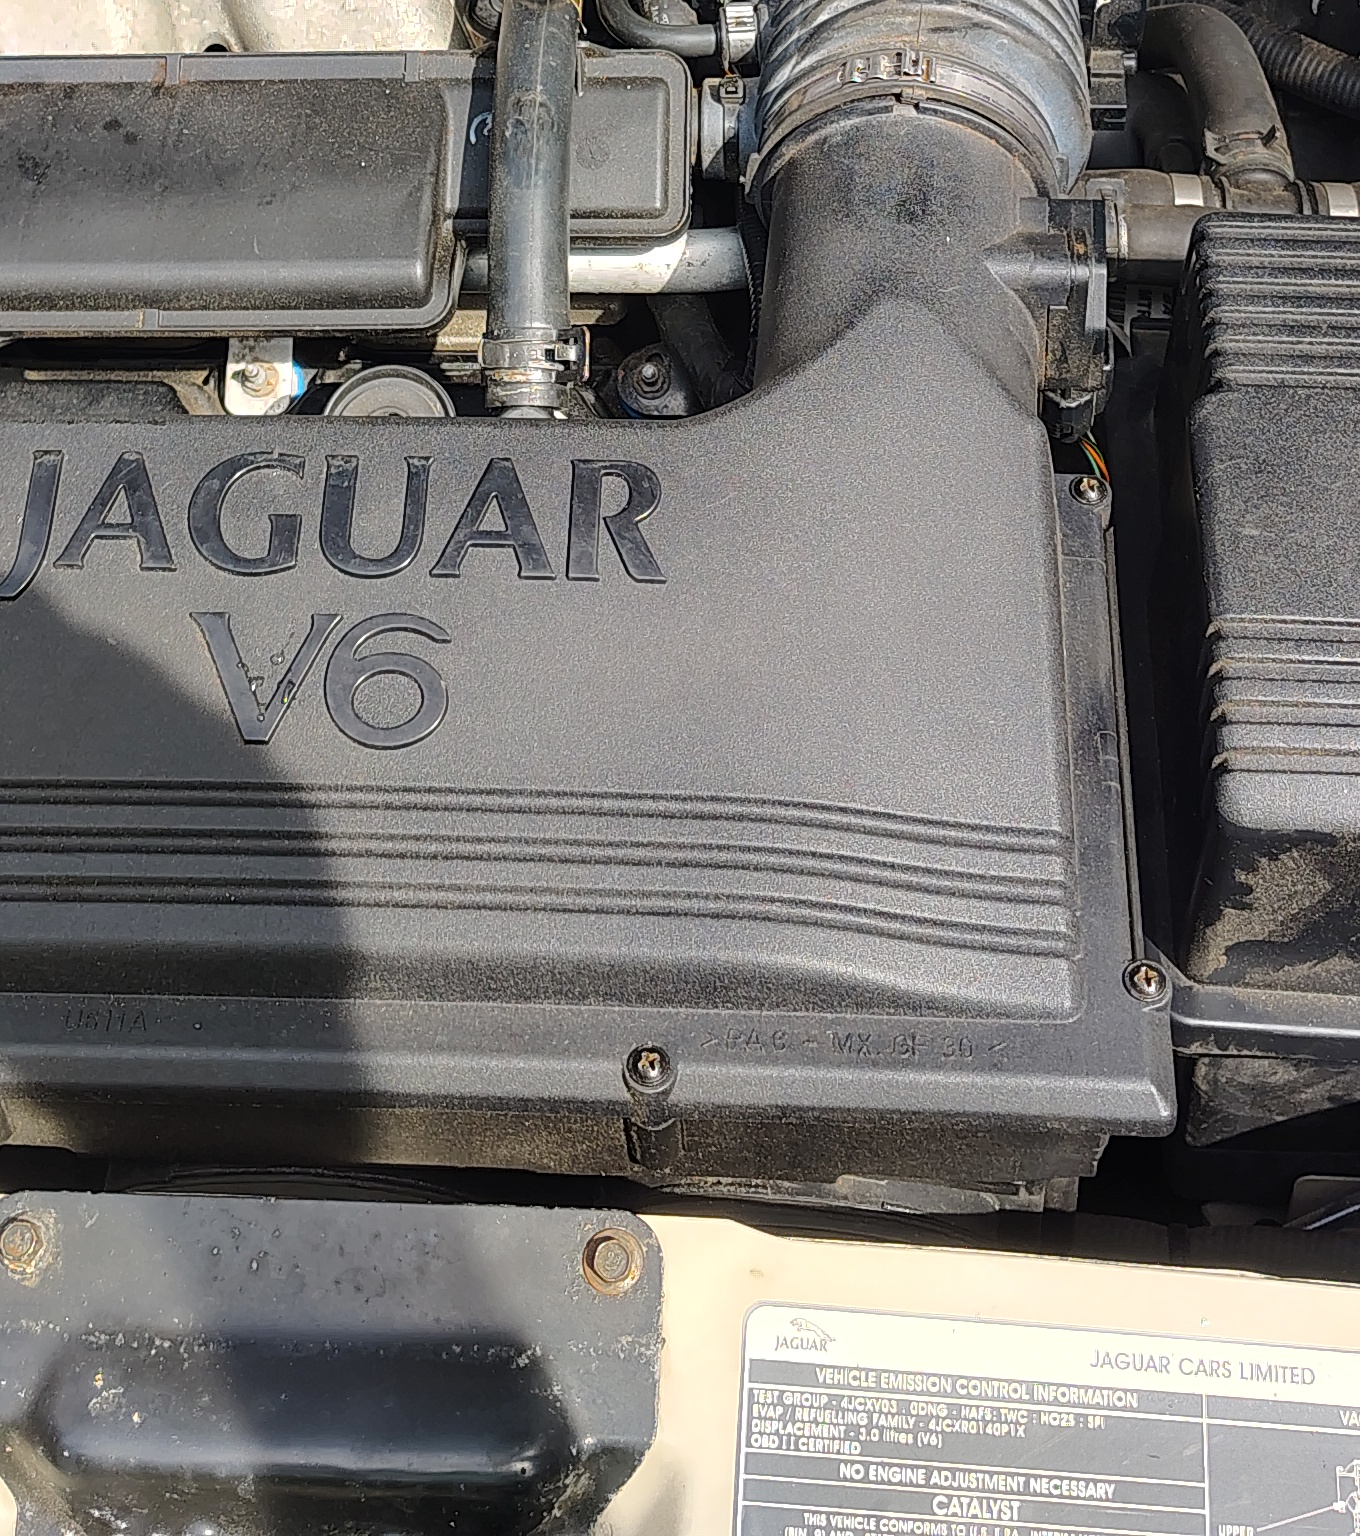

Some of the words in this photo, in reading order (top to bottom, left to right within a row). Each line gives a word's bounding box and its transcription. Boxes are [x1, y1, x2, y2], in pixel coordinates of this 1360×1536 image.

[189, 611, 452, 750] V6
[775, 1335, 828, 1352] JAGUAR
[1090, 1349, 1170, 1374] JAGUAR
[1179, 1358, 1232, 1378] CARS
[1240, 1361, 1316, 1385] LIMITED
[816, 1367, 876, 1387] VEHICLE
[880, 1373, 952, 1394] EMISSION
[956, 1378, 1029, 1400] CONTROL
[1034, 1383, 1138, 1408] INFORMATION
[752, 1404, 783, 1420] EVAP
[795, 1409, 868, 1426] REFUELLING
[873, 1413, 916, 1430] FAMILY
[753, 1389, 779, 1404] TEST
[783, 1393, 828, 1407] GROUP
[1000, 1408, 1028, 1424] TWC
[750, 1434, 779, 1448] OBD
[798, 1439, 862, 1455] CERTIFIED
[751, 1419, 846, 1439] DISPLACEMENT
[859, 1428, 879, 1442] 3.0
[883, 1429, 914, 1444] litres
[918, 1432, 942, 1448] (V6)
[840, 1462, 865, 1480] NO
[868, 1465, 926, 1485] ENGINE
[929, 1470, 1026, 1493] ADJUSTMENT
[1029, 1478, 1116, 1500] NECESSARY
[932, 1495, 1020, 1521] CATALYST
[803, 1512, 827, 1527] THIS
[829, 1514, 877, 1531] VEHICLE
[879, 1518, 948, 1536] CONFORMS
[950, 1523, 966, 1536] TO
